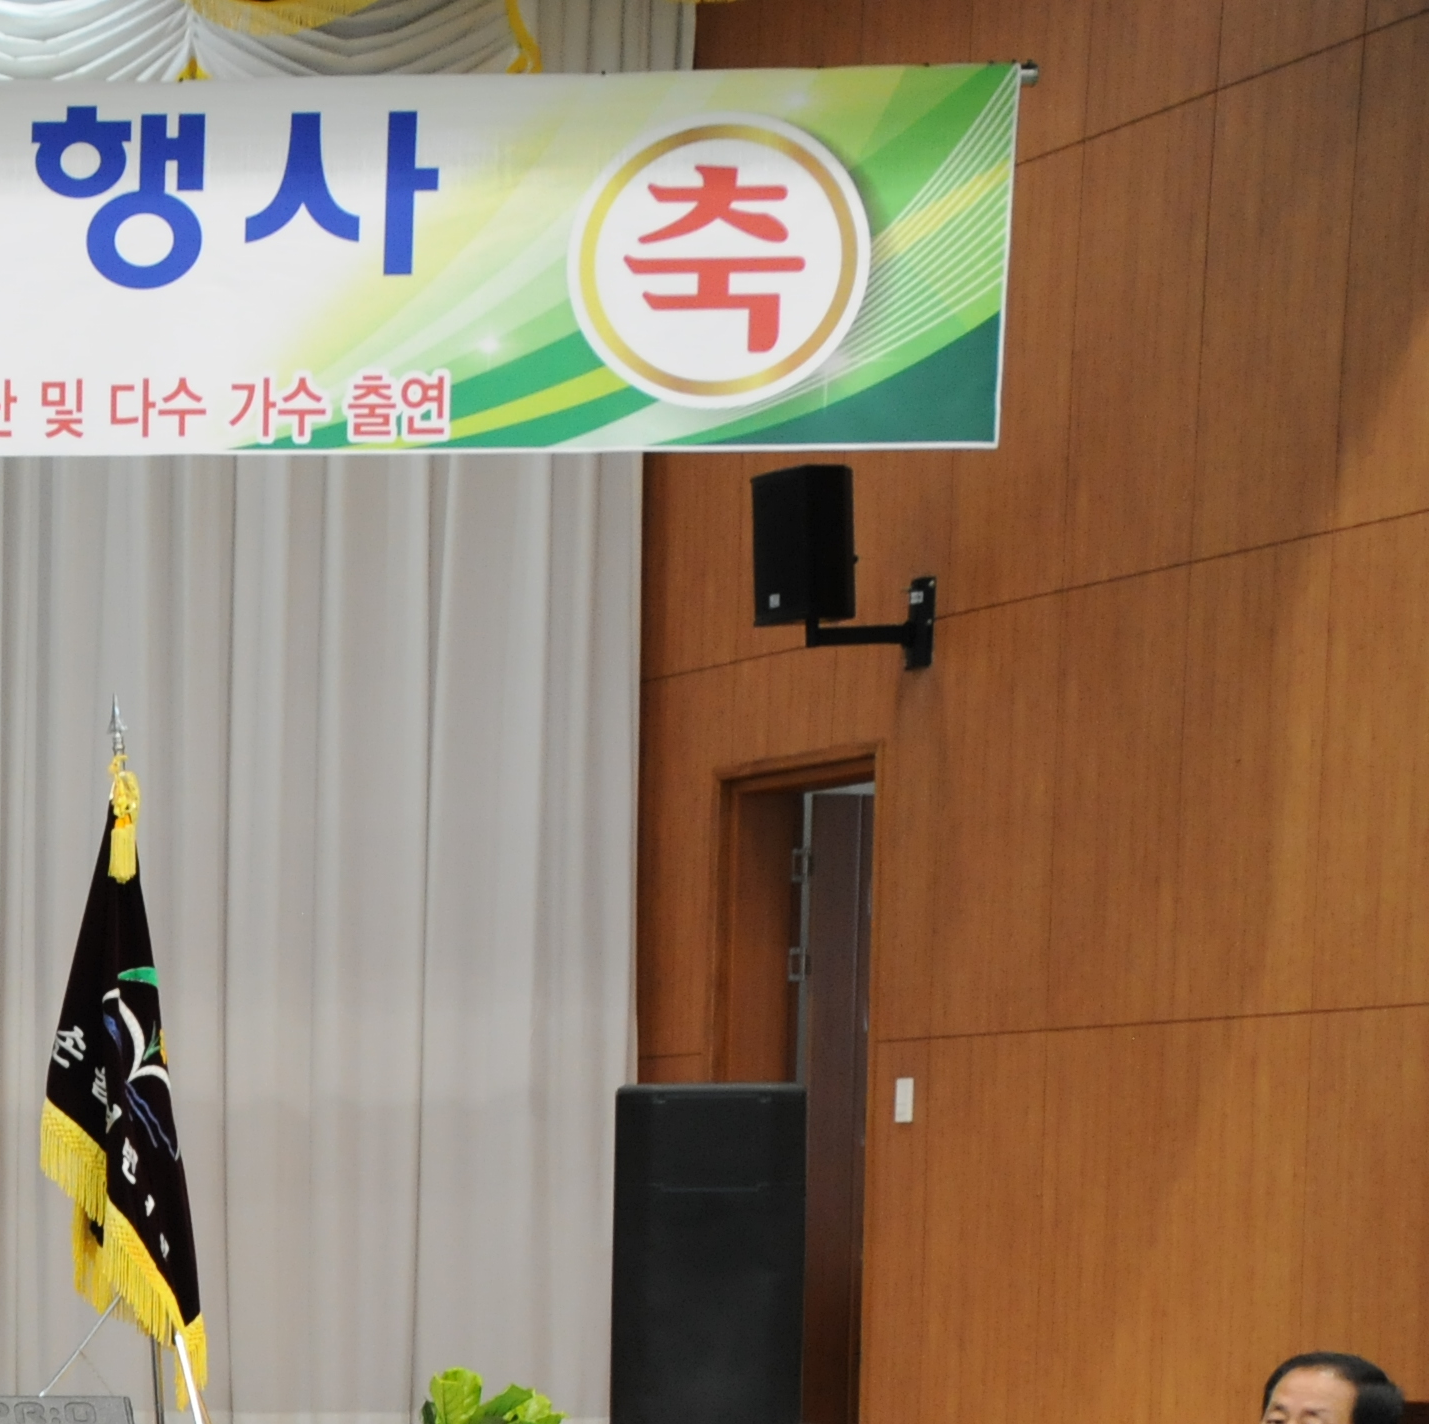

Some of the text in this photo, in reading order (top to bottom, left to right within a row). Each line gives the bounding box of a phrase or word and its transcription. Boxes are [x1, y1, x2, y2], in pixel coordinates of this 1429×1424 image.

[32, 105, 440, 290] 행사
[624, 165, 806, 353] 축
[41, 378, 84, 438] 및
[110, 377, 208, 437] 다수
[229, 377, 327, 437] 가수
[348, 374, 446, 437] 출연
